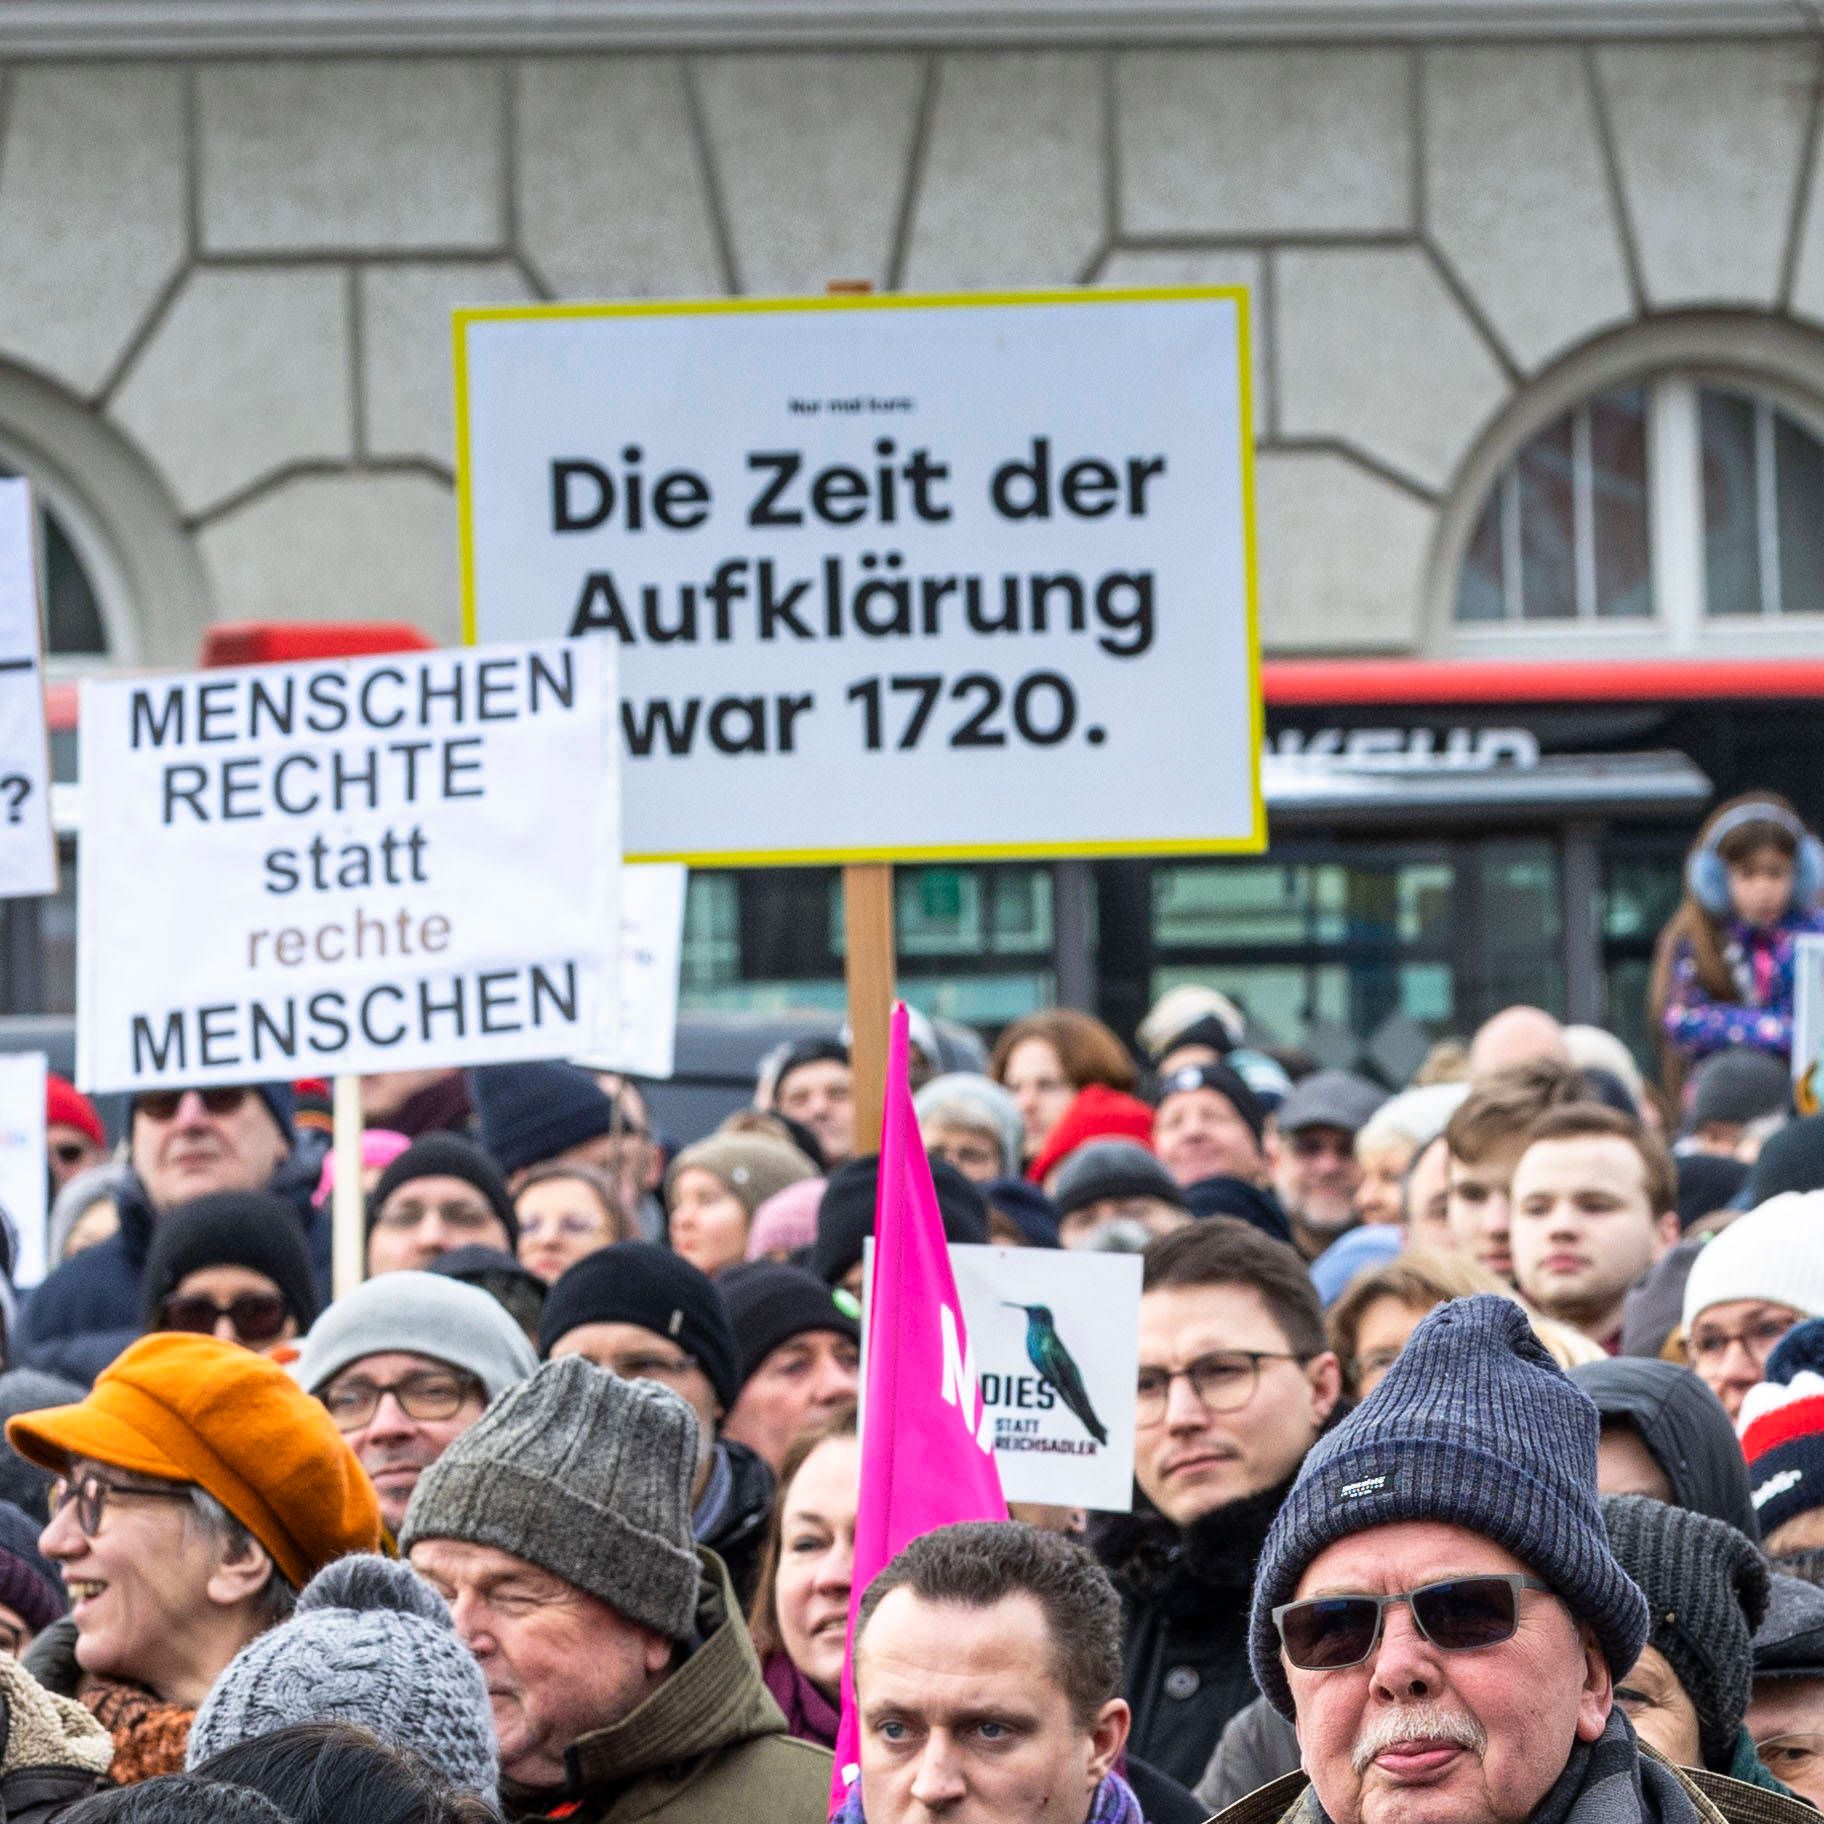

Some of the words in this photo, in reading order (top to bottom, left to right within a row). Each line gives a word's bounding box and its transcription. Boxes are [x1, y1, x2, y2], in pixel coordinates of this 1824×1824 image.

[550, 444, 710, 534] Die
[748, 438, 951, 527] Zeit
[991, 436, 1167, 521] der
[569, 553, 1156, 657] Aufklärung
[129, 649, 575, 748] MENSCHEN
[622, 688, 813, 757] war
[847, 670, 1108, 750] 1720.
[162, 736, 486, 824] RECHTE
[264, 824, 429, 894] statt
[247, 906, 453, 969] rechte
[132, 962, 578, 1076] MENSCHEN
[994, 1417, 1040, 1435] STATT
[994, 1436, 1098, 1456] REICHSADLER
